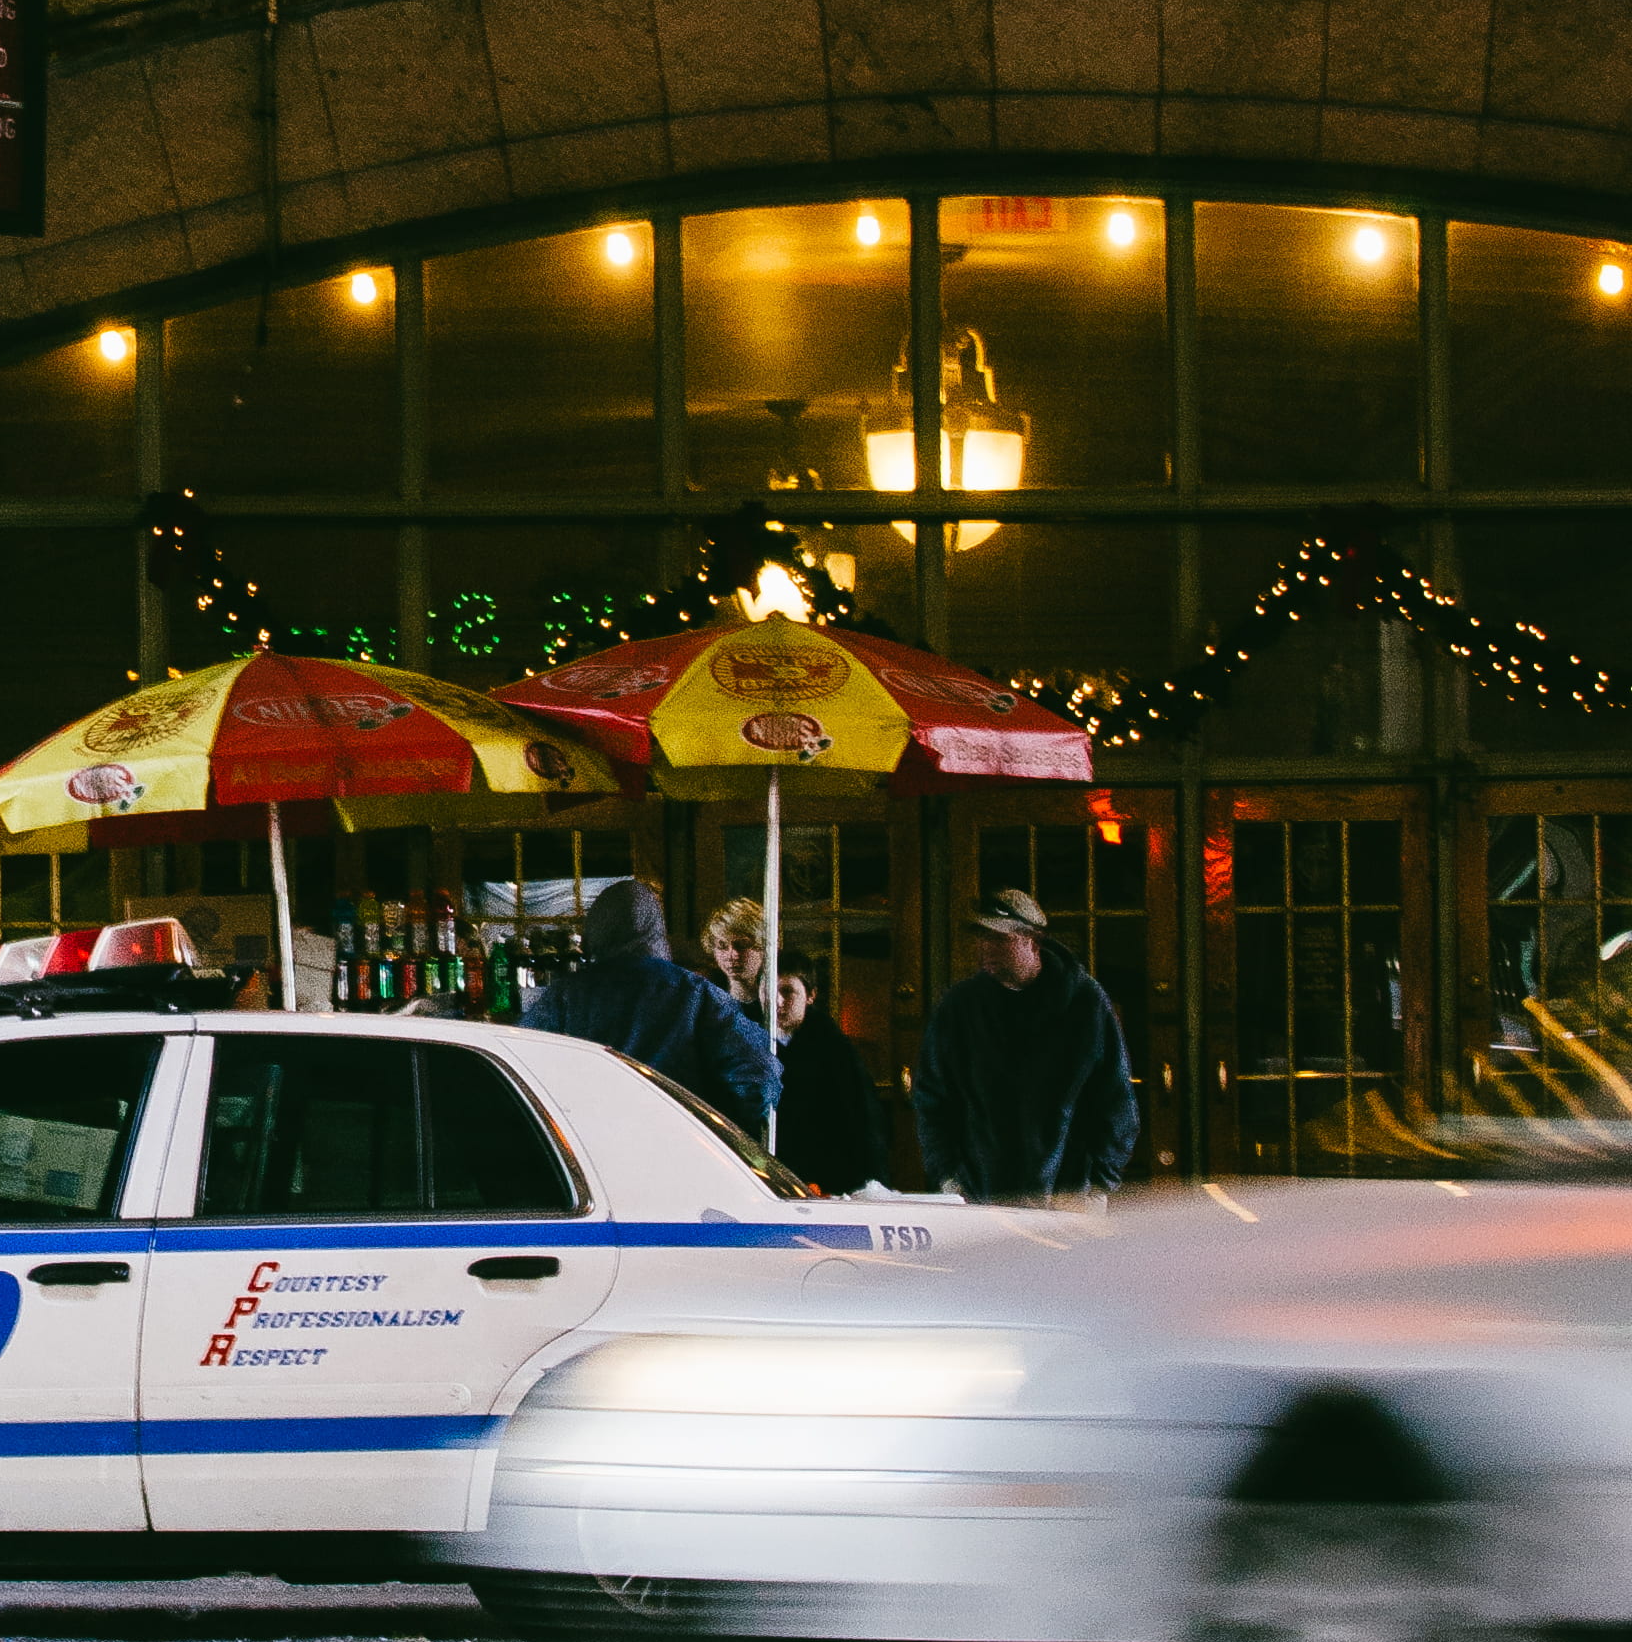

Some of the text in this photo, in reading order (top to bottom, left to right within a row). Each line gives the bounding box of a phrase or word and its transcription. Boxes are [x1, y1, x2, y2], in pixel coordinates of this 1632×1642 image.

[879, 1225, 933, 1251] FSD
[247, 1261, 388, 1293] COURTESY
[223, 1295, 465, 1329] PROFESSIONALISM
[199, 1333, 329, 1366] RESPECT
